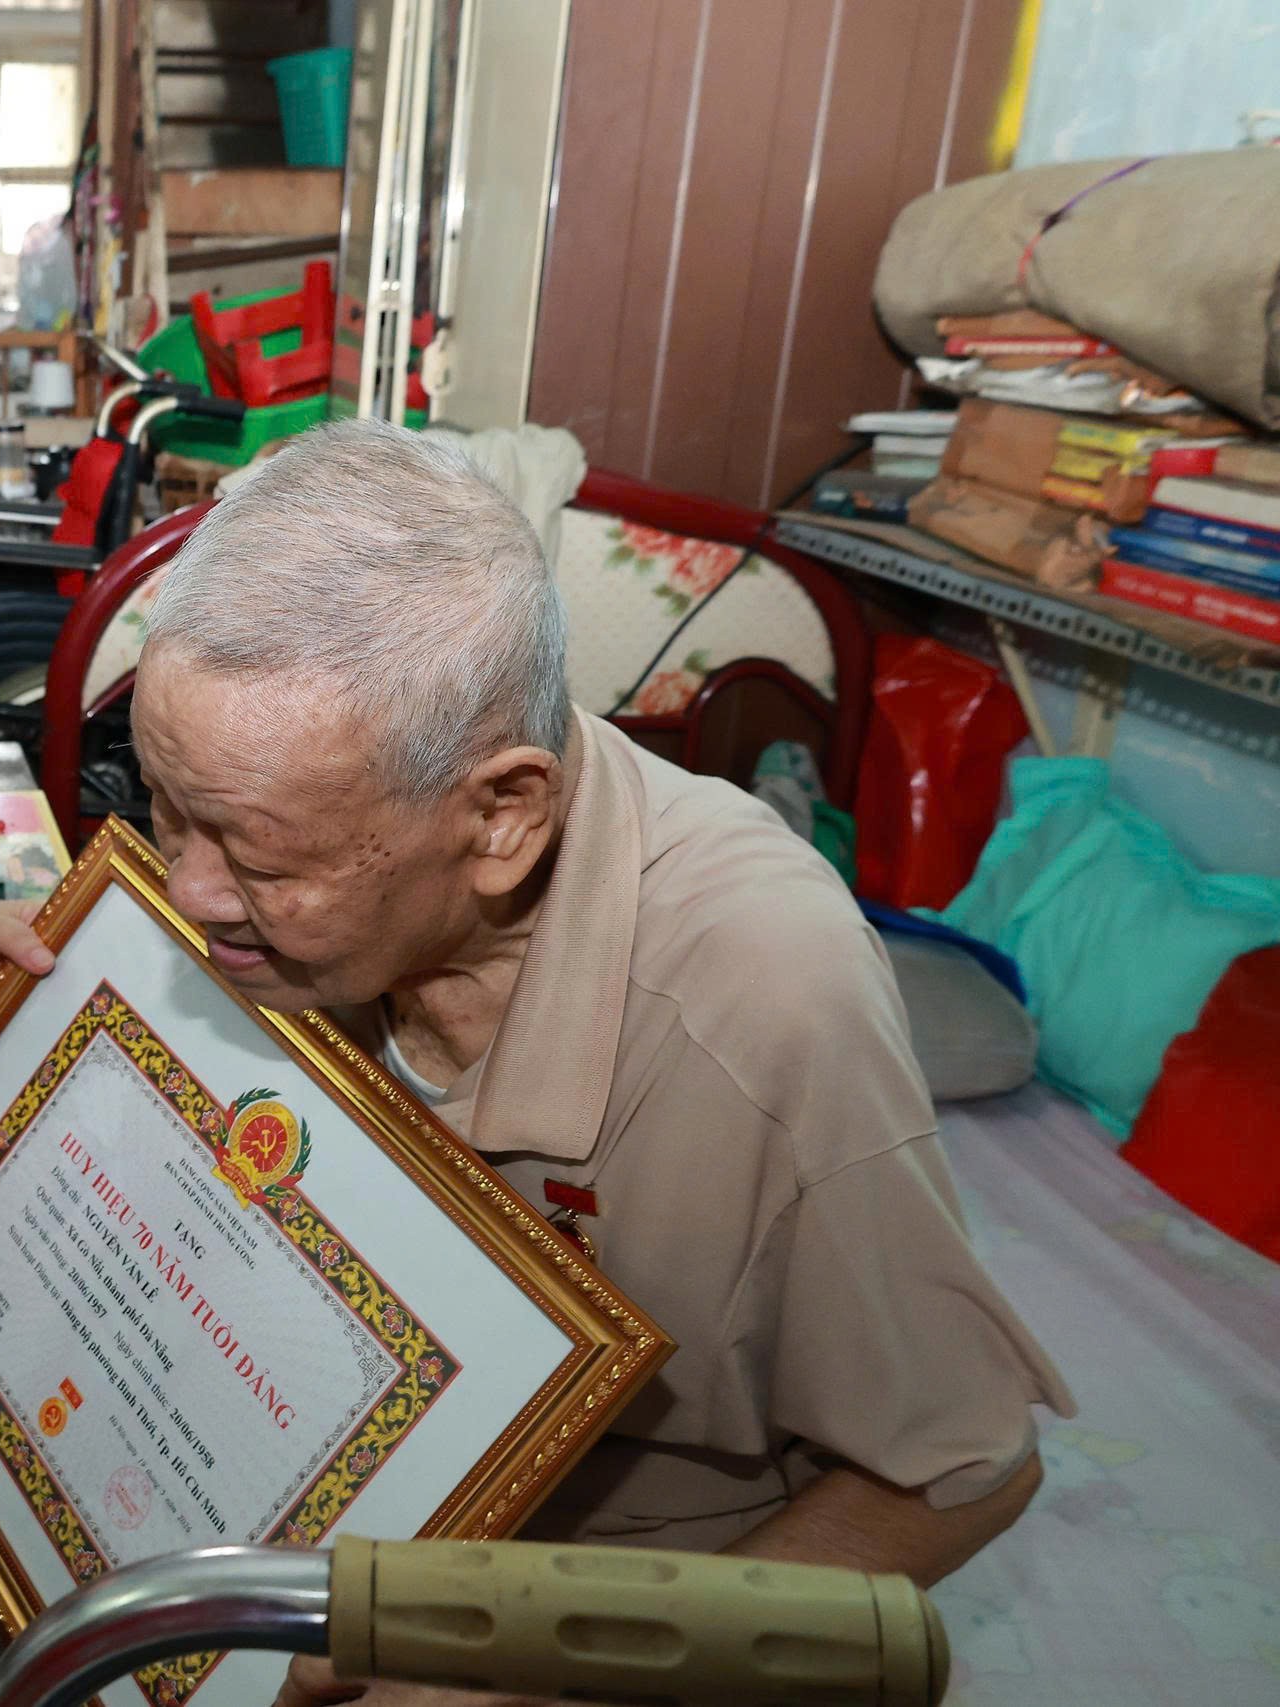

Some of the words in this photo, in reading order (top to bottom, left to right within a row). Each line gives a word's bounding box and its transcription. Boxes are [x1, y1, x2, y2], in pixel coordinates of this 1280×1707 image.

[173, 1218, 207, 1260] TẶNG
[239, 1228, 259, 1251] NAM
[58, 1131, 98, 1176] HUY
[91, 1171, 136, 1226] HIỆU
[131, 1220, 154, 1251] 70
[148, 1244, 195, 1302] NĂM
[190, 1294, 239, 1359] TUỔI
[234, 1353, 296, 1430] ĐẢNG
[139, 1280, 160, 1304] LÊ
[121, 1304, 145, 1327] phố
[66, 1266, 108, 1319] 20/06/1957
[112, 1329, 135, 1360] Ngày
[131, 1357, 153, 1387] chính
[168, 1407, 215, 1470] 20/06/1958
[77, 1323, 93, 1345] bộ
[115, 1377, 137, 1408] Bình
[169, 1454, 188, 1478] Hồ
[184, 1474, 205, 1502] Chí
[199, 1497, 226, 1535] Minh
